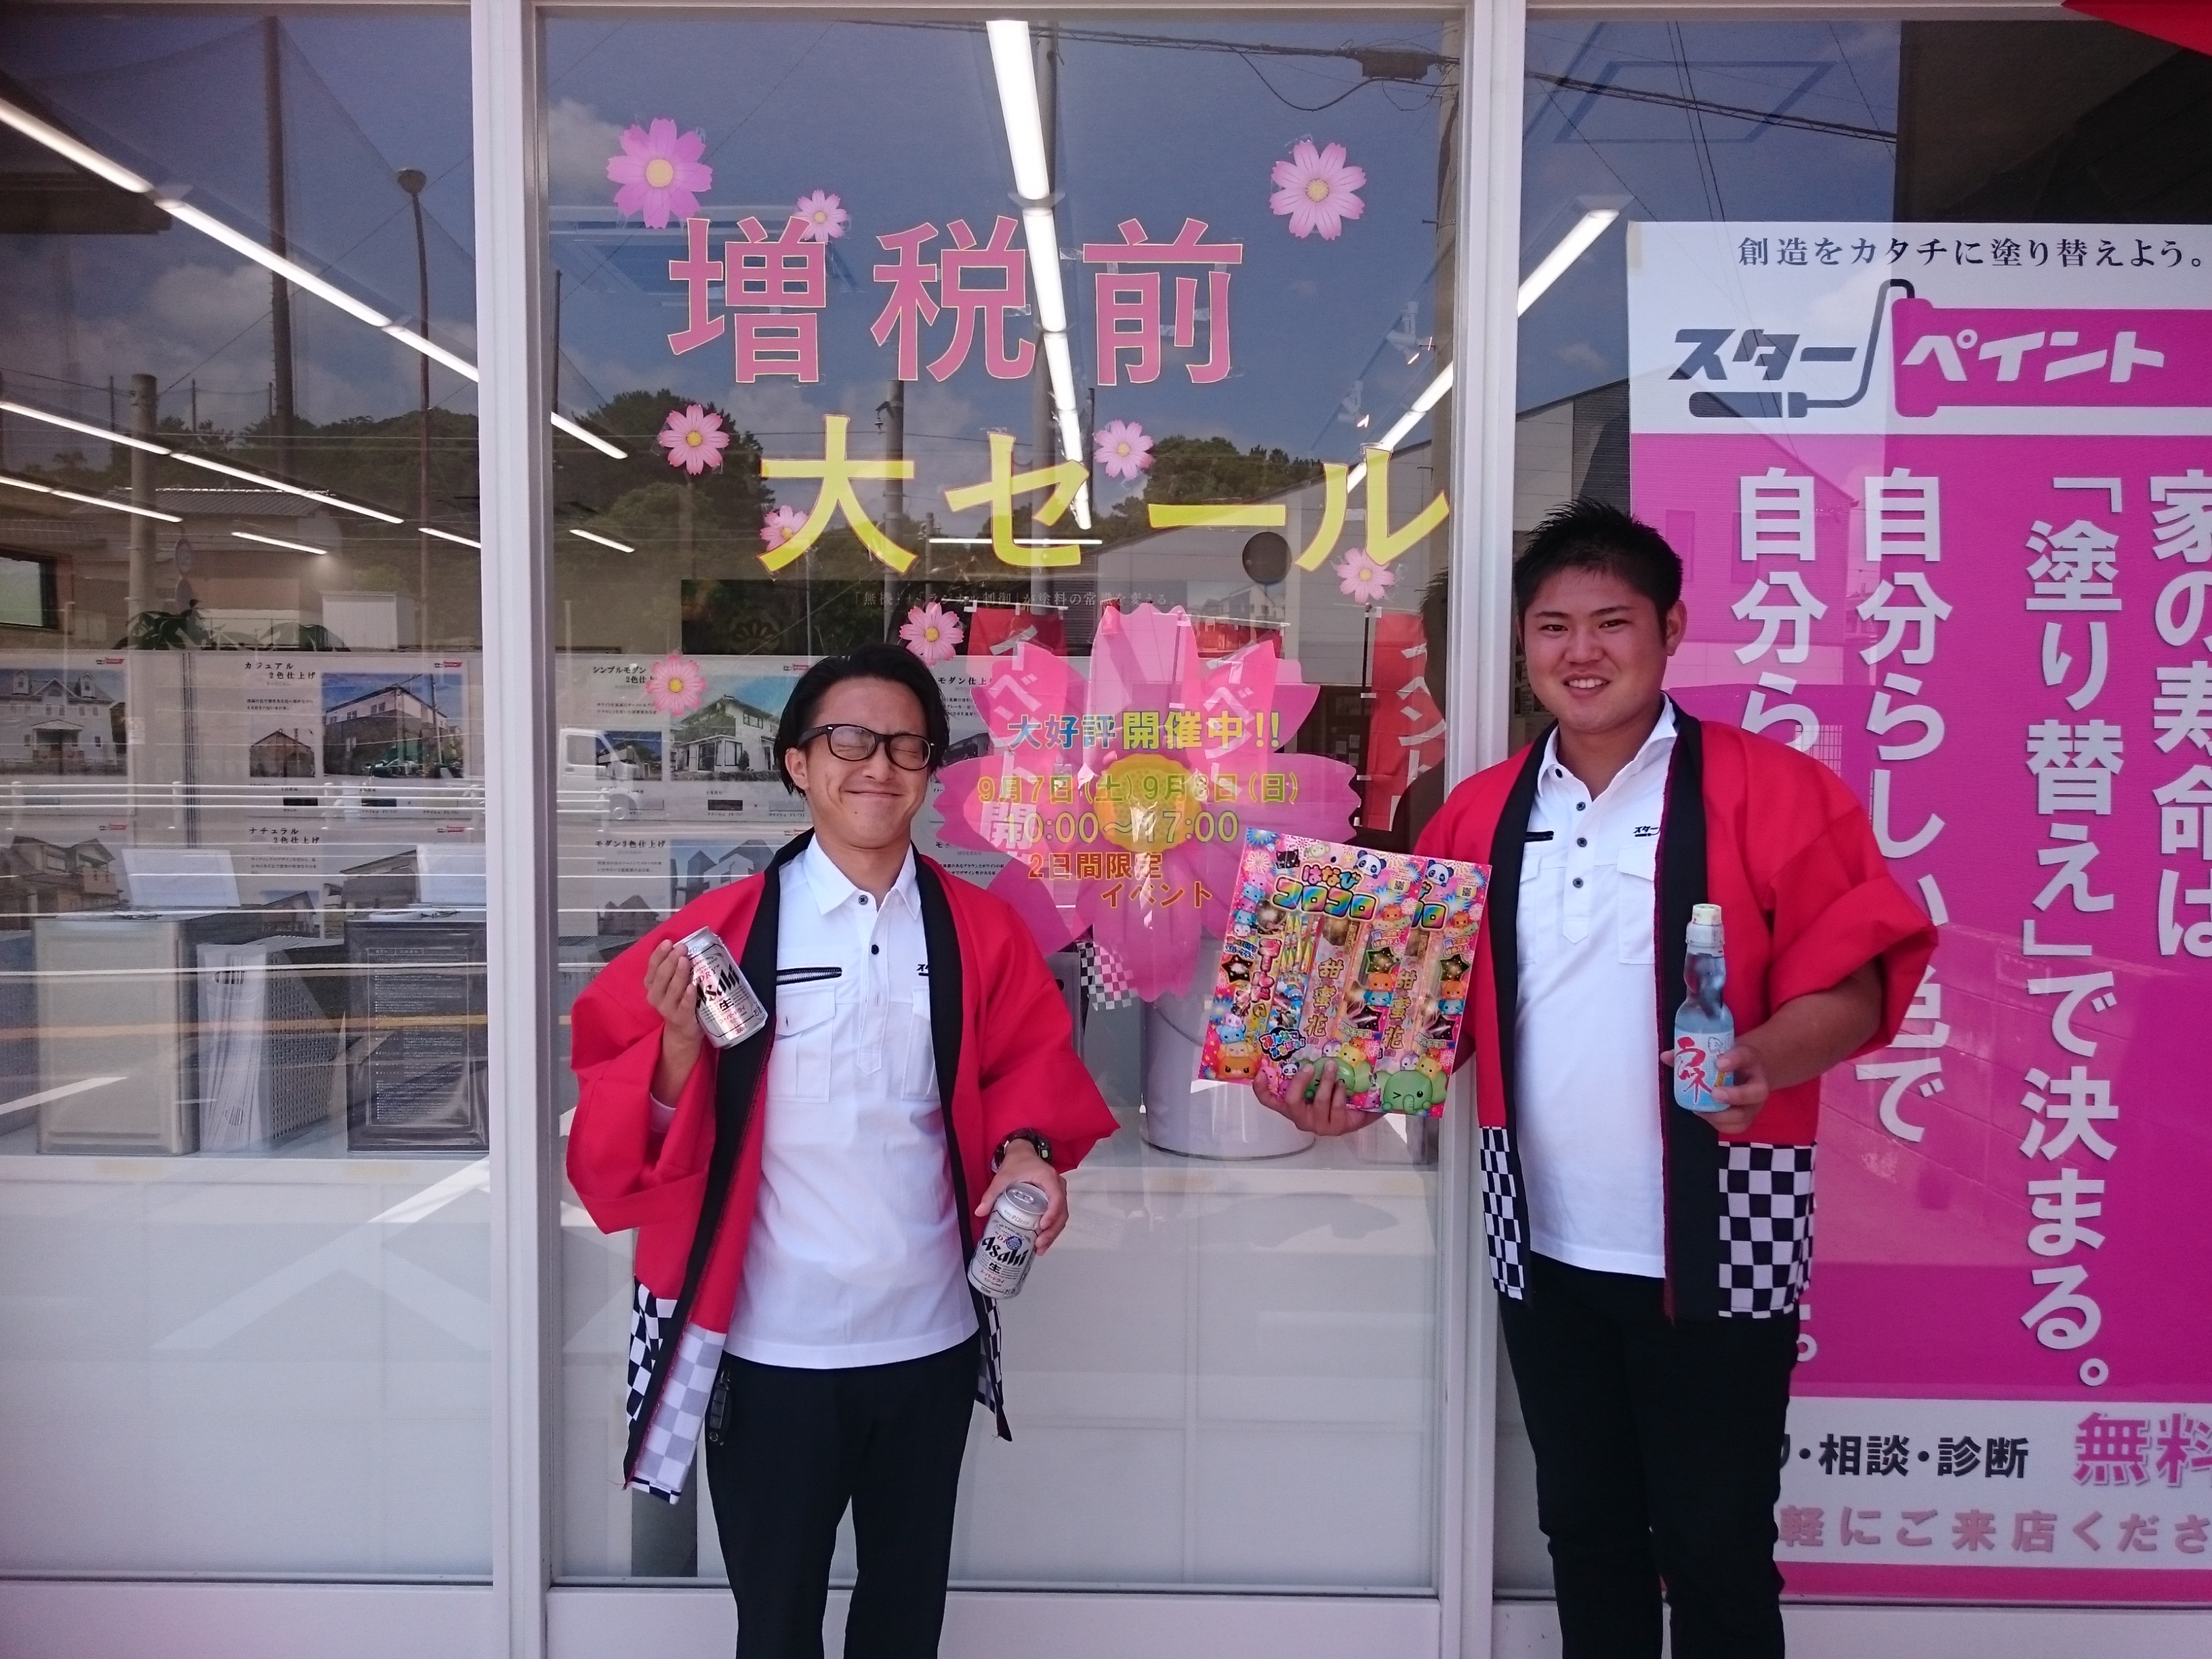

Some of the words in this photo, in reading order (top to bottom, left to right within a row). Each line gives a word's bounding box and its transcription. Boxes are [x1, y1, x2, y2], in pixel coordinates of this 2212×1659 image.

[1738, 237, 2203, 268] 創造をカタチに塗り替えよう。
[668, 216, 1243, 385] 増税前
[1668, 329, 1857, 381] スター
[1901, 329, 2165, 383] ペイント
[757, 414, 1450, 574] 大セール
[269, 671, 316, 680] 2色仕上げ
[592, 665, 647, 674] シンプルモダン
[249, 827, 299, 835] ナチュラル
[273, 836, 320, 844] 2色仕上げ
[594, 839, 665, 848] モダン2色仕上げ
[1027, 851, 1163, 880] 2日間限定
[1301, 863, 1362, 891] はなび
[1101, 881, 1212, 909] イベント
[1271, 876, 1377, 922] コロコロ
[2020, 477, 2125, 1387] 「塗り替え」で決まる。
[719, 998, 735, 1012] 生
[981, 1235, 1029, 1267] Asahi
[987, 1261, 1002, 1274] 生
[2072, 1410, 2212, 1488] 無料
